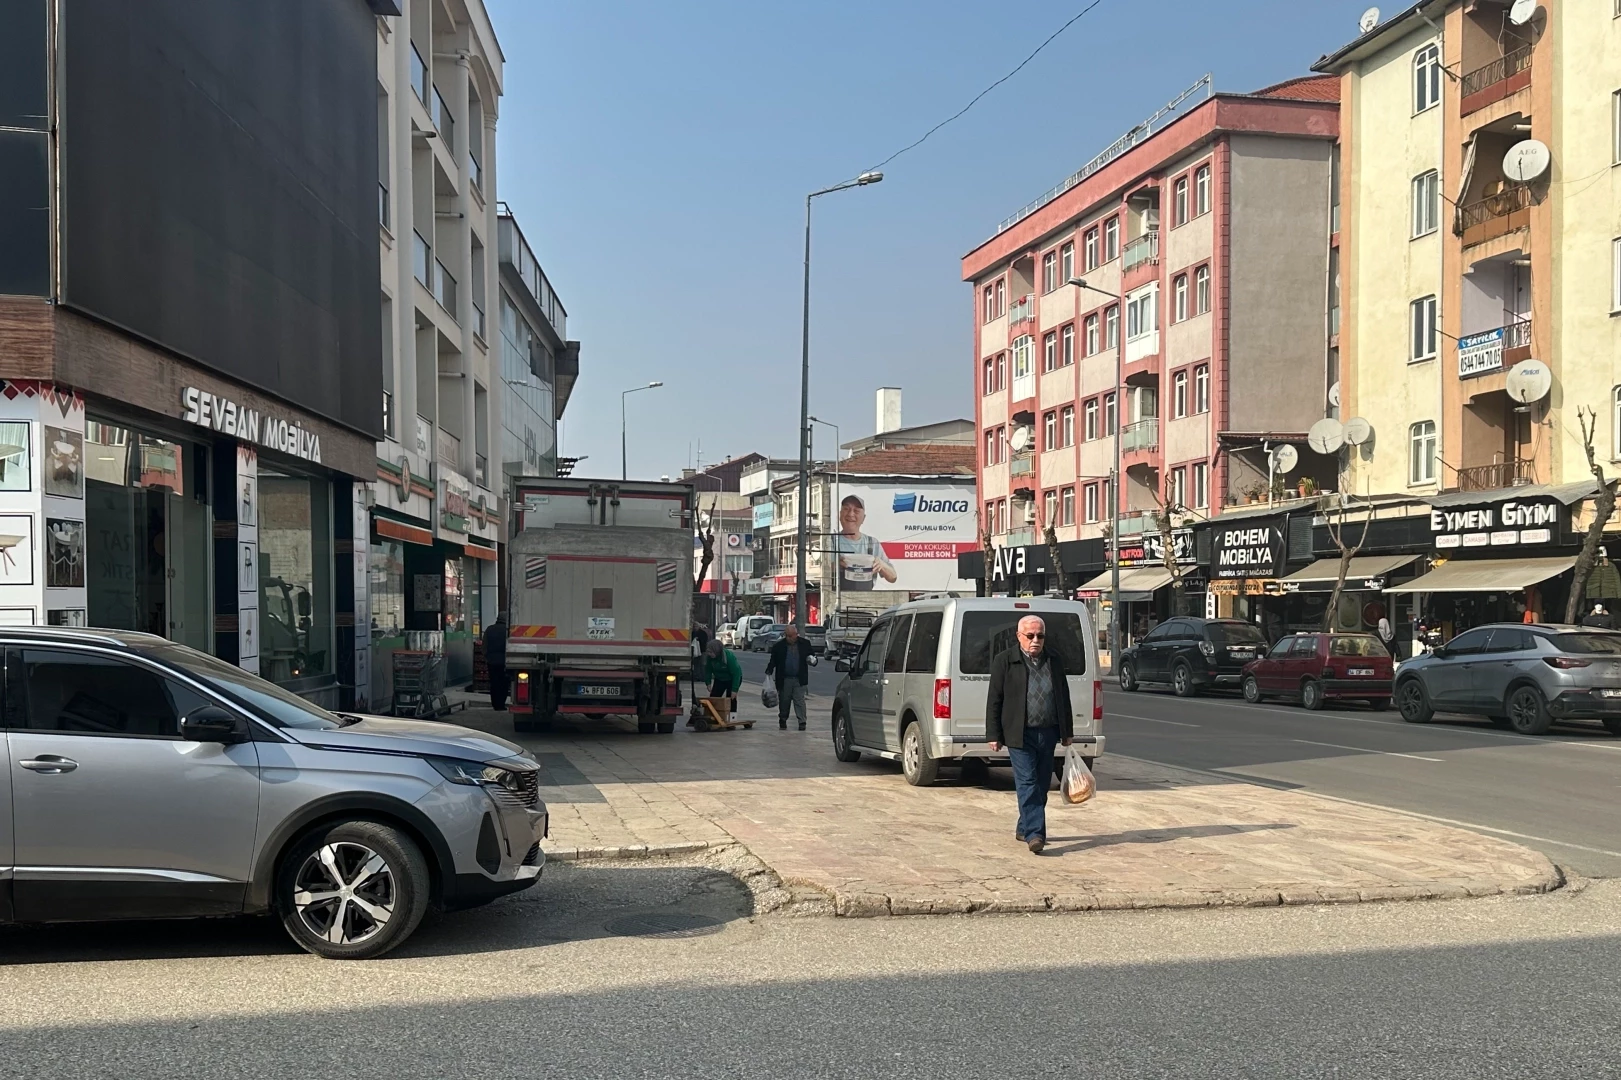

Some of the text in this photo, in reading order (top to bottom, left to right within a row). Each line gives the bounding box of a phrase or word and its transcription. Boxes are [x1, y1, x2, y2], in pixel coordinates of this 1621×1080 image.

[1518, 148, 1538, 156] AEG
[1460, 355, 1474, 373] 0544
[183, 386, 259, 443] SEVBAN
[918, 495, 969, 512] bianca
[1430, 509, 1493, 531] EYMEN
[1224, 527, 1270, 547] BOHEM
[992, 544, 1026, 582] Ava
